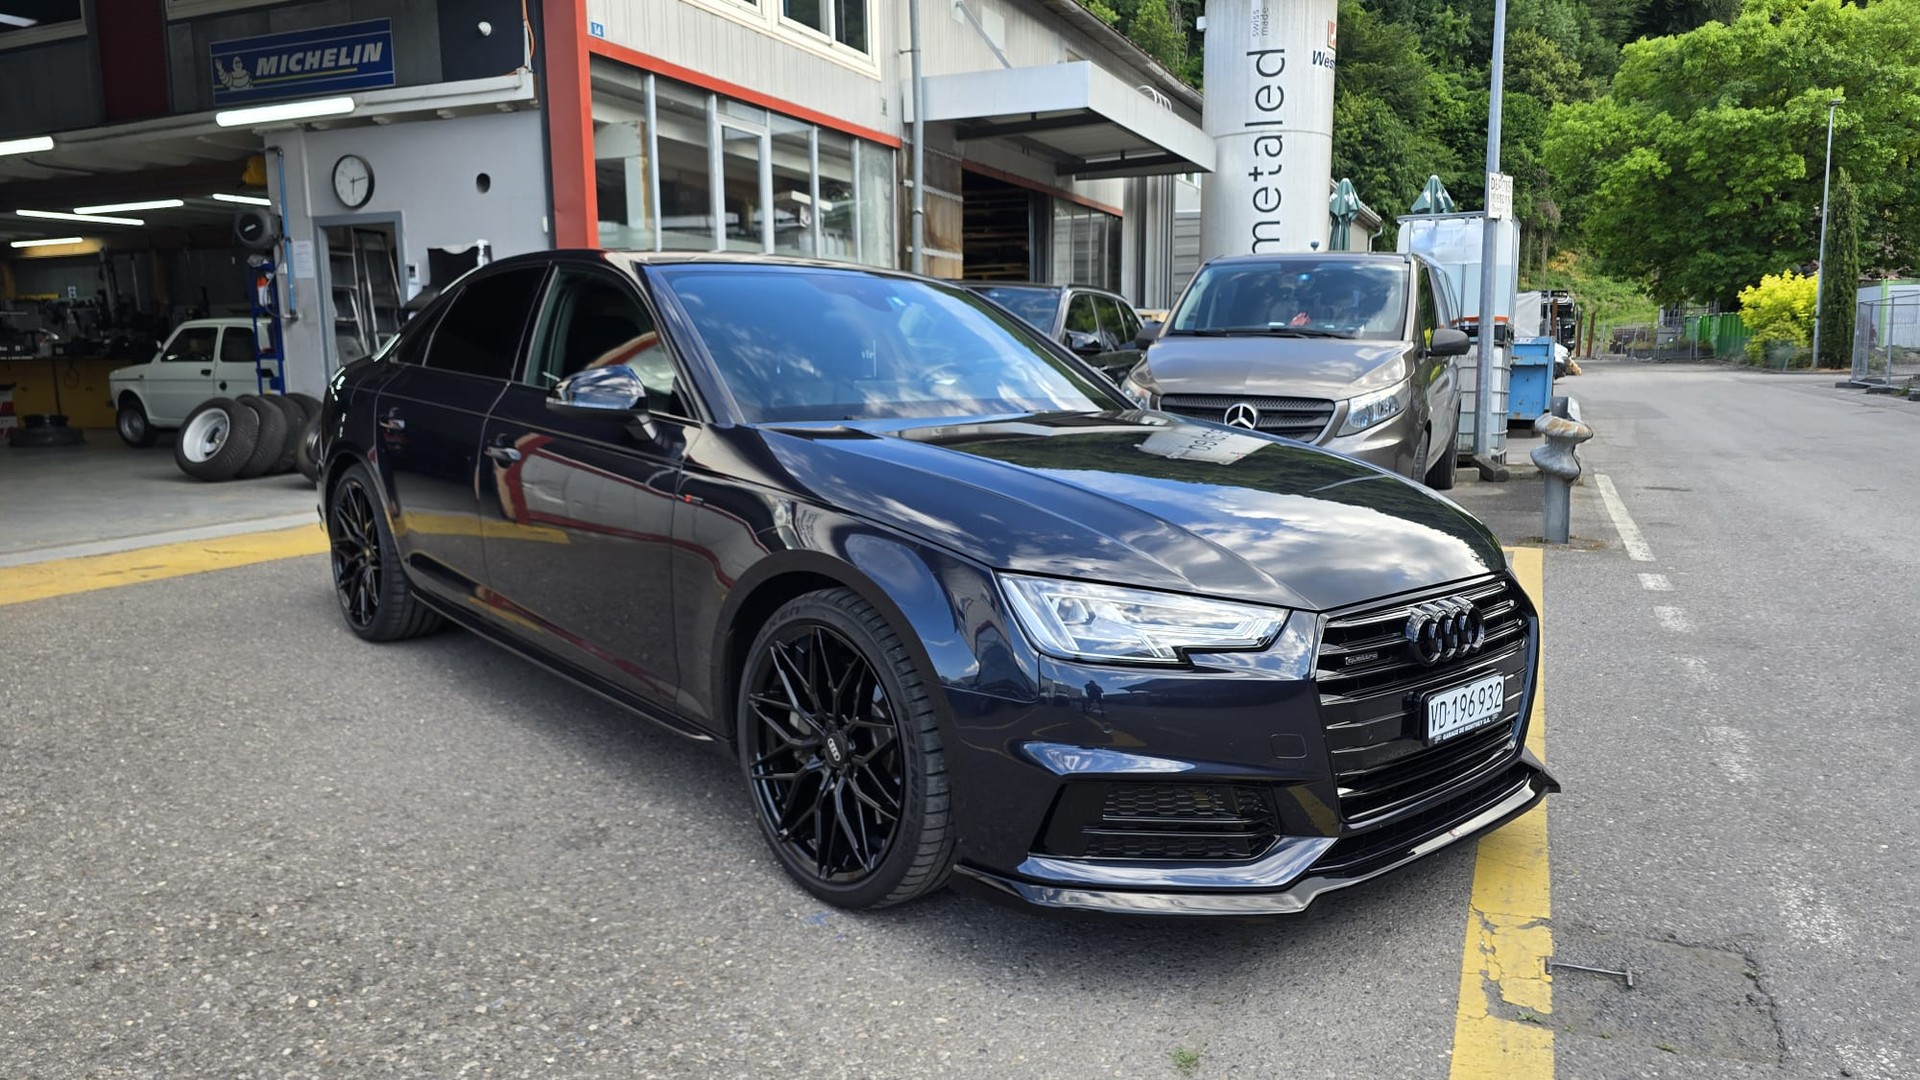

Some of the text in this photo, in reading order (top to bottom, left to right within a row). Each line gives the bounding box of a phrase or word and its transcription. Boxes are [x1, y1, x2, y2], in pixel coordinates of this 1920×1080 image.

[594, 24, 601, 35] 14
[1260, 7, 1269, 37] made
[256, 42, 383, 76] MICHELIN
